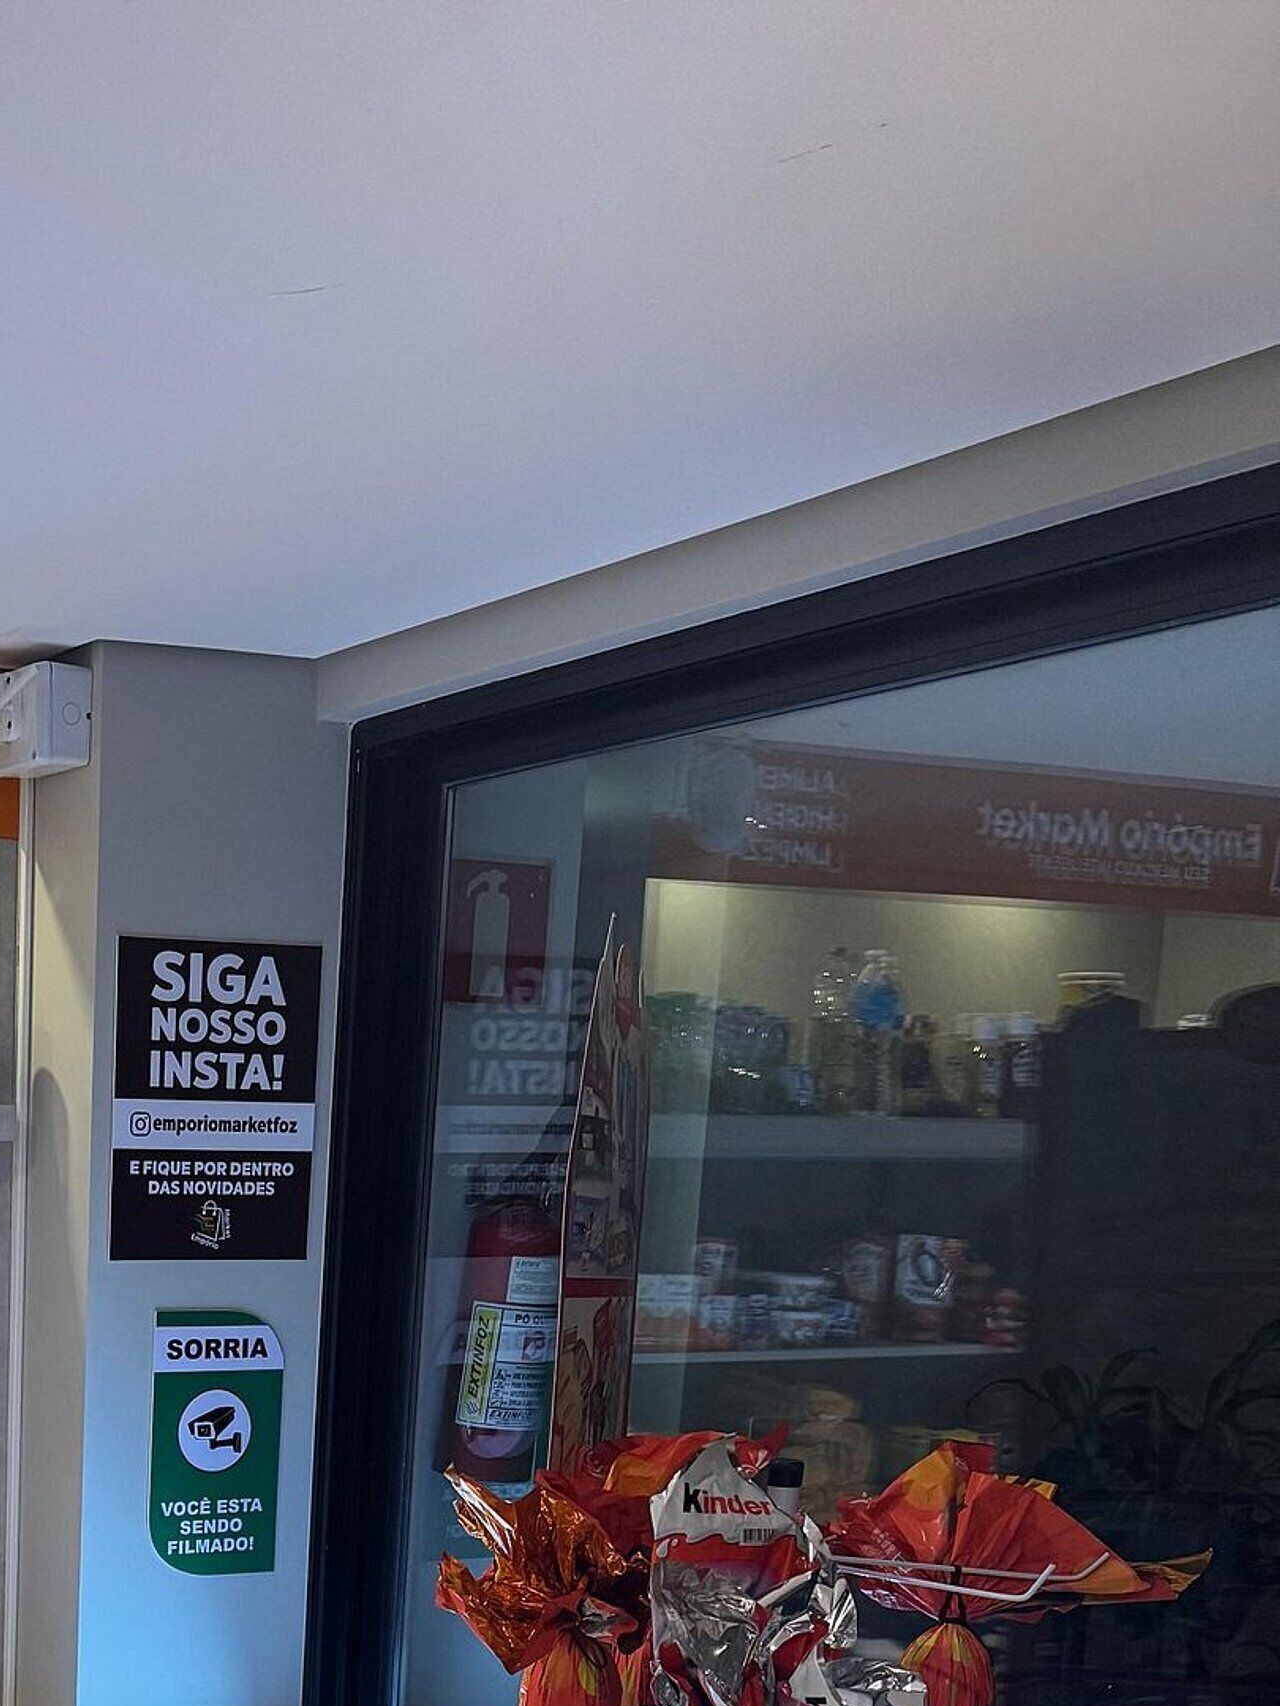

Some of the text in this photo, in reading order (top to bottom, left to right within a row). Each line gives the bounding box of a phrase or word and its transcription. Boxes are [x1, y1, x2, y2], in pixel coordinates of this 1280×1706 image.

[151, 950, 287, 1006] SIGA
[151, 1007, 287, 1046] NOSSO
[149, 1050, 285, 1091] INSTA!
[153, 1114, 299, 1137] emporiomarketfoz
[129, 1161, 294, 1177] E FIQUE POR DENTRO
[148, 1180, 275, 1196] DAS NOVIDADES
[166, 1337, 269, 1361] SORRIA
[467, 1314, 491, 1399] EXTINFOZ
[161, 1496, 263, 1517] VOCÊ ESTA
[179, 1518, 243, 1536] SENDO
[167, 1535, 255, 1556] FILMADO!
